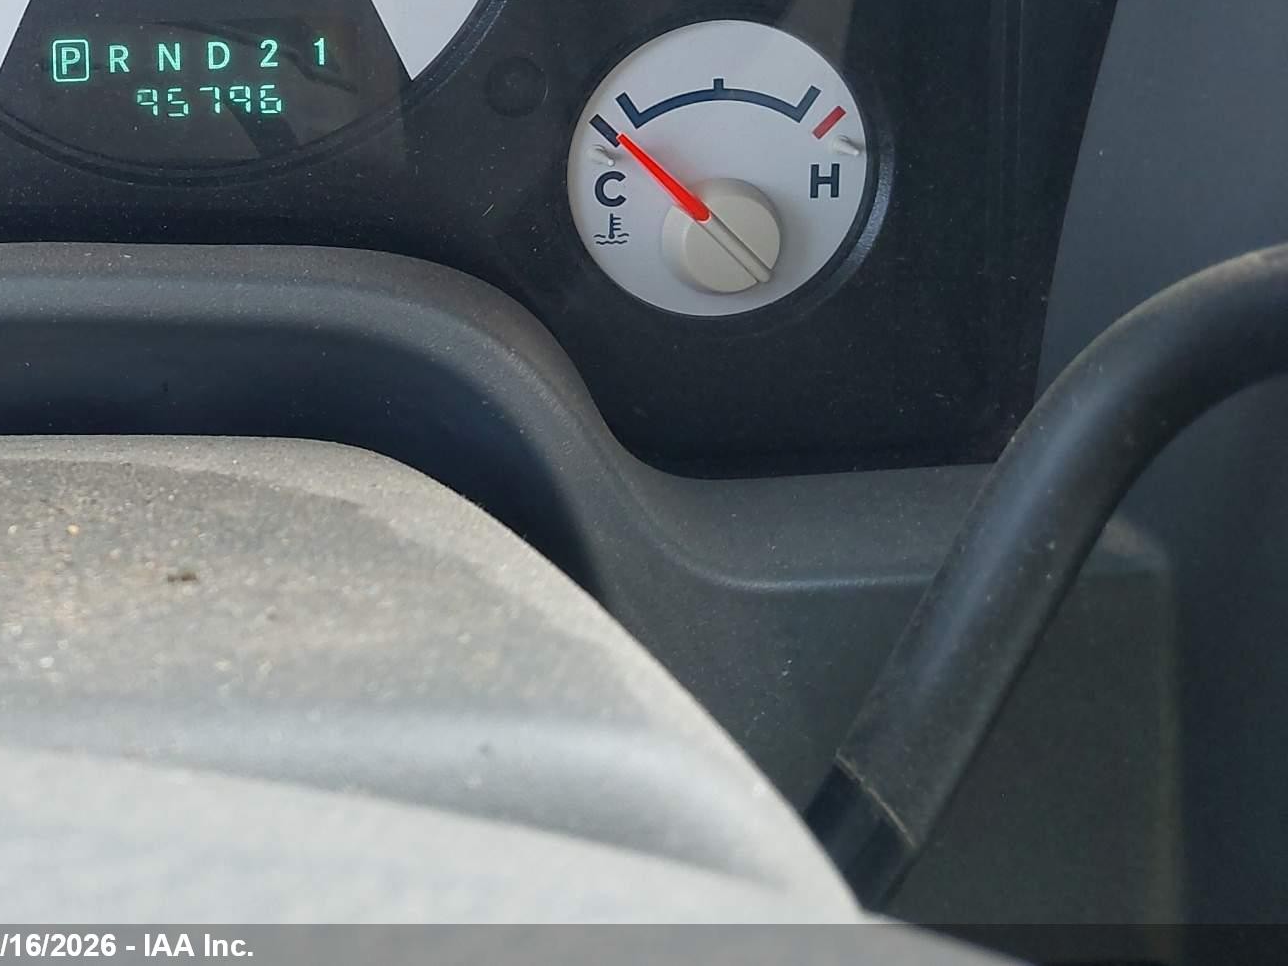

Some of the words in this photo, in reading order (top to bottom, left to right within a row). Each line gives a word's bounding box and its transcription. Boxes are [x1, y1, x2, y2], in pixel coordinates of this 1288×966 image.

[62, 47, 81, 74] P
[109, 45, 129, 72] R
[158, 43, 181, 71] N
[208, 42, 230, 69] D
[260, 40, 278, 67] 2
[313, 38, 325, 65] 1
[137, 85, 281, 116] 95796
[595, 171, 626, 207] C
[810, 164, 840, 198] H
